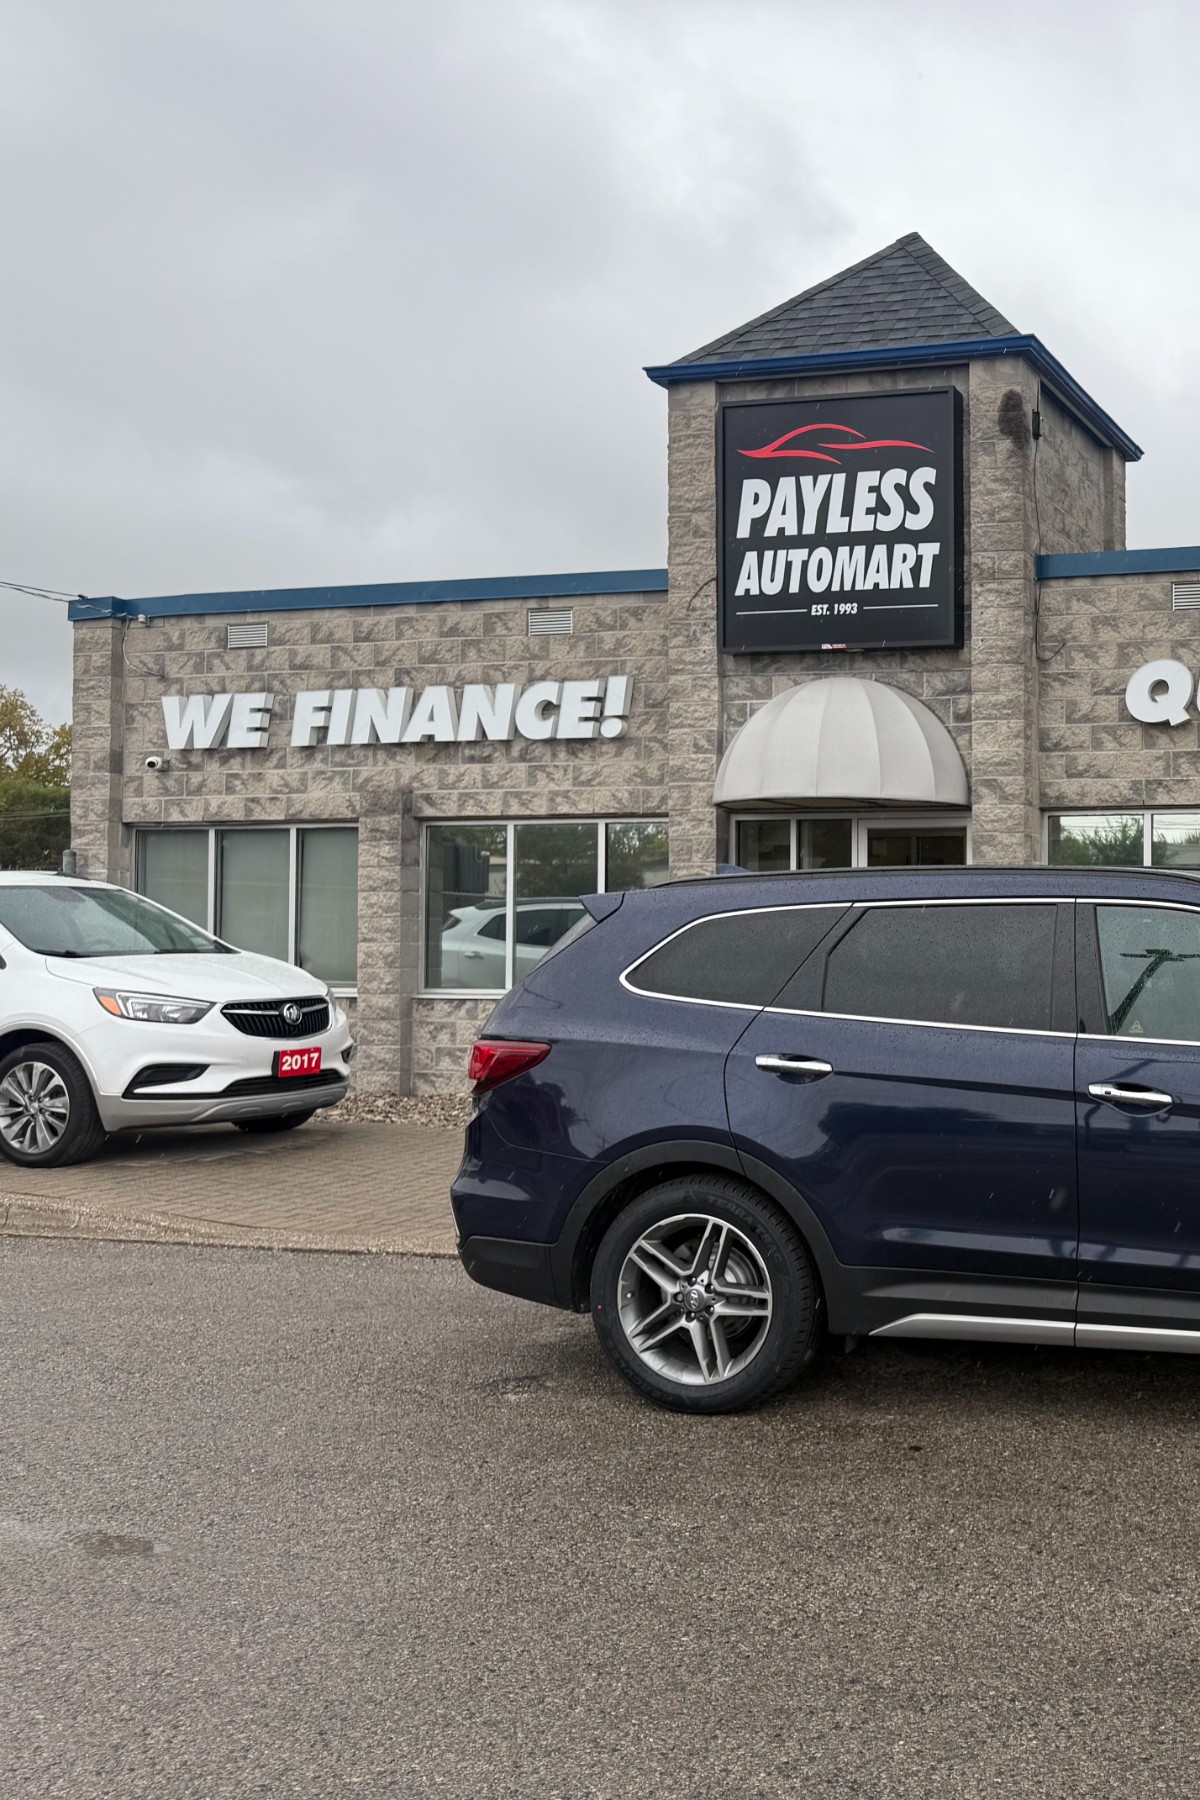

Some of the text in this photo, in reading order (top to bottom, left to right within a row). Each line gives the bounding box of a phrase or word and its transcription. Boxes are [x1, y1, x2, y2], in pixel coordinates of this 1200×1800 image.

[736, 467, 936, 539] PAYLESS
[735, 542, 940, 597] AUTOMART
[811, 603, 858, 616] EST. 1993
[161, 676, 632, 750] WE FINANCE!
[281, 1052, 319, 1071] 2017
